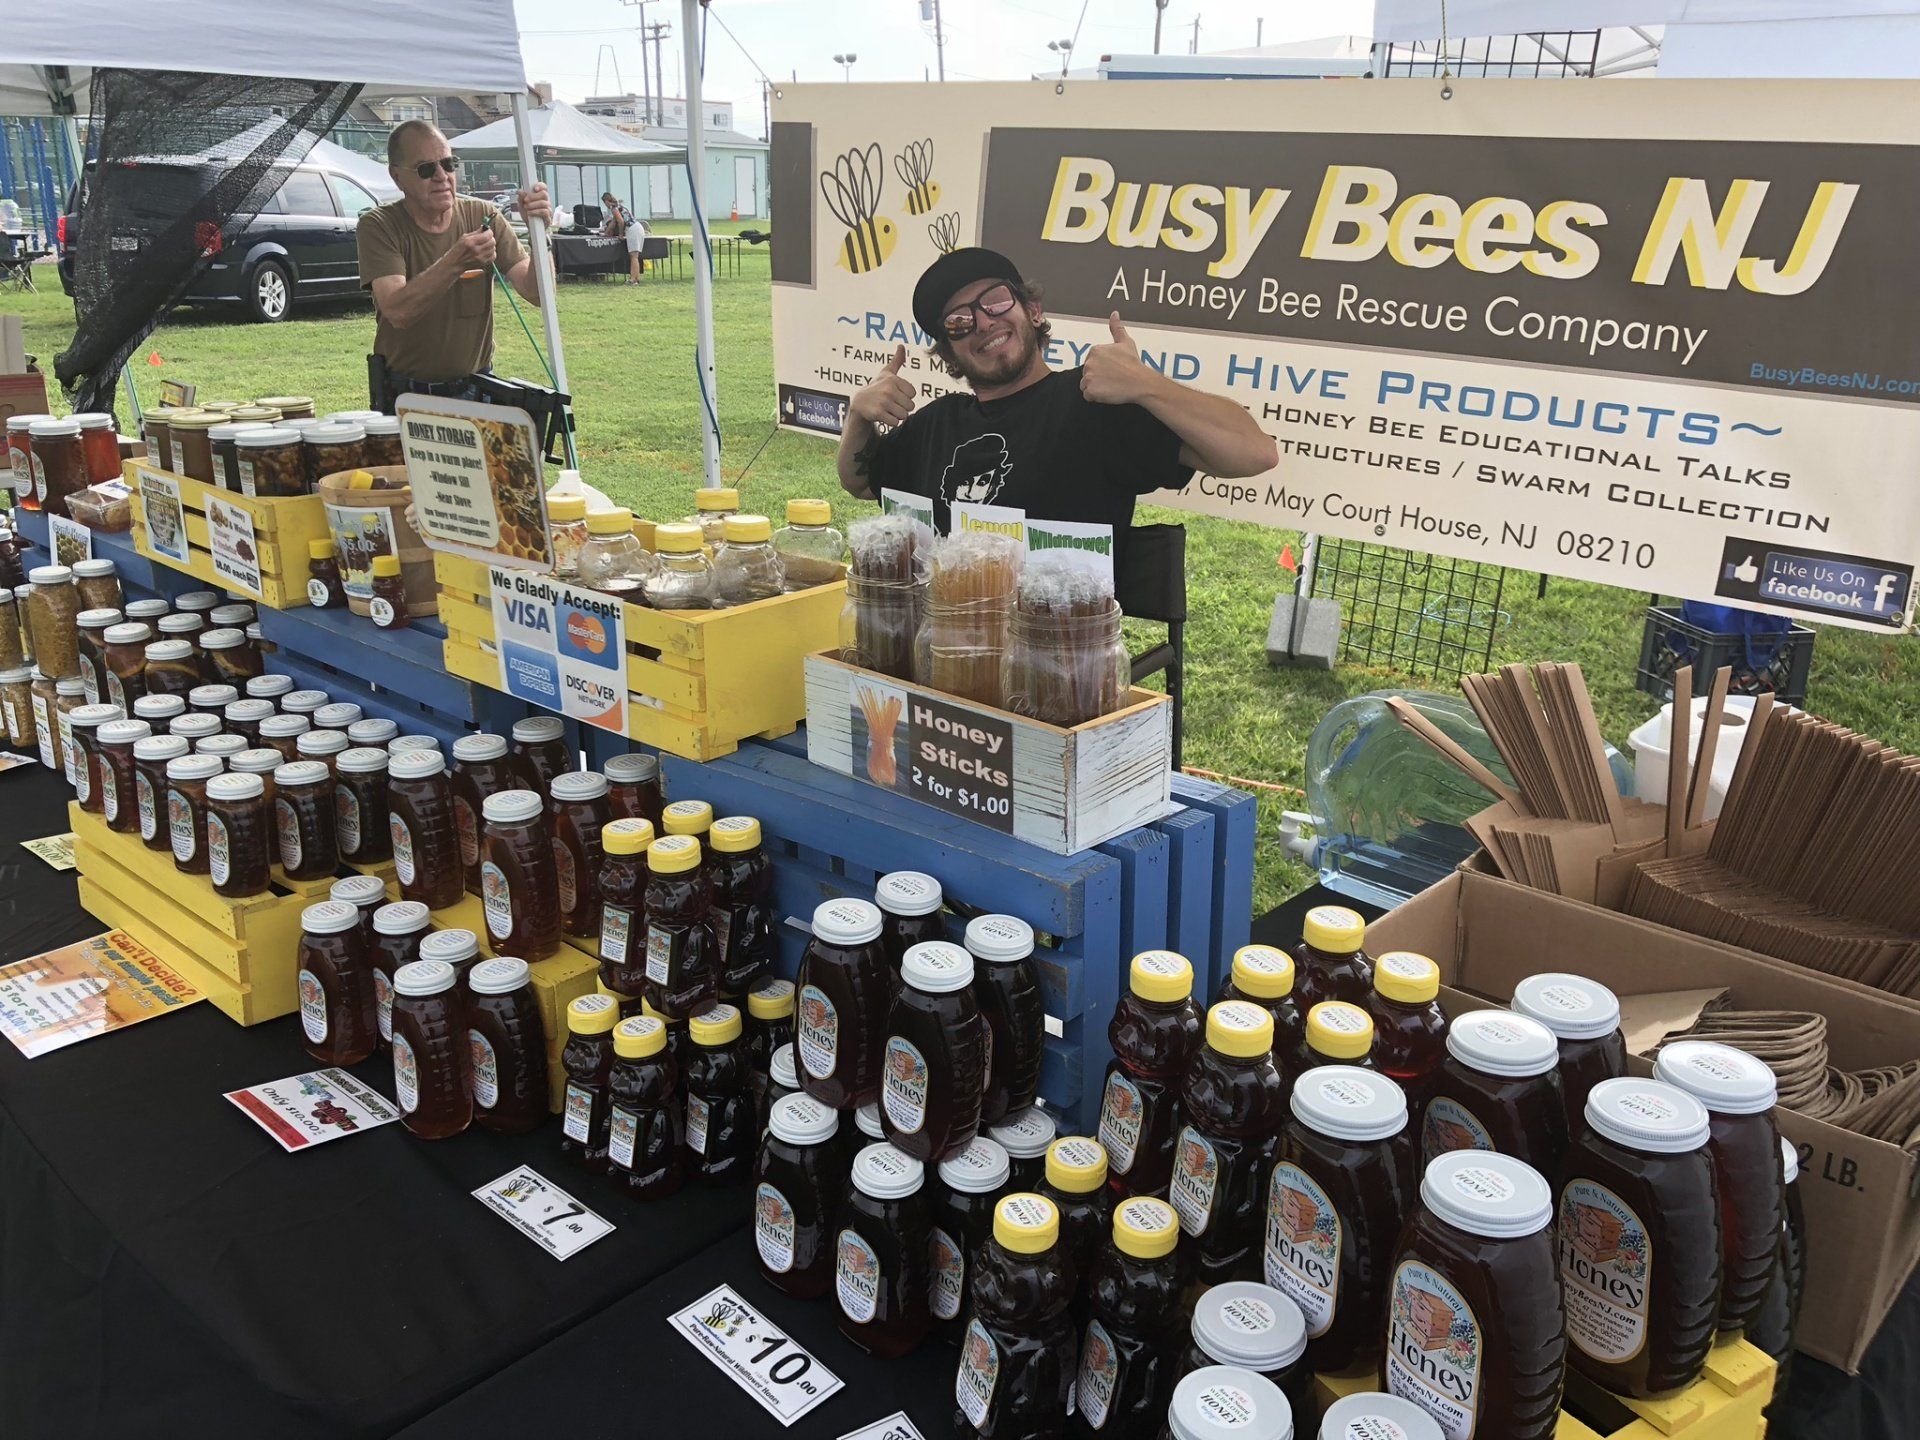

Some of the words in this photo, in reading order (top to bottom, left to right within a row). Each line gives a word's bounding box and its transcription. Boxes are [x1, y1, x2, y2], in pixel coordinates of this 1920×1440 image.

[1040, 156, 1292, 279] Busy
[1300, 164, 1608, 280] Bees
[1631, 176, 1861, 296] NJ
[1107, 266, 1130, 300] A
[1142, 273, 1246, 321] Honey
[1258, 278, 1321, 318] Bee
[1336, 284, 1468, 331] Rescue
[1485, 296, 1708, 365] Company
[844, 345, 920, 369] FARME'S
[1140, 350, 1200, 380] ND
[1227, 354, 1349, 400] HIVE
[798, 397, 813, 409] Like
[814, 401, 823, 411] Us
[824, 404, 834, 412] On
[798, 409, 836, 426] facebook
[436, 425, 477, 448] STORAGE
[1263, 402, 1356, 431] HONEY
[1369, 415, 1424, 442] BEE
[1440, 425, 1661, 473] EDUCATIONAL
[1677, 456, 1791, 489] TALKS
[1272, 436, 1441, 475] TRUCTURES
[1476, 464, 1591, 498] SWARM
[1607, 483, 1831, 533] COLLECTION
[960, 511, 1024, 542] Lemon
[1199, 475, 1257, 505] Cape
[1264, 484, 1315, 517] May
[1323, 493, 1392, 525] Court
[1399, 504, 1489, 546] House,
[1501, 520, 1539, 550] NJ
[1556, 528, 1656, 570] 08210
[1027, 526, 1112, 556] Wildflower
[1773, 560, 1808, 578] Like
[1813, 567, 1834, 582] Us
[1840, 571, 1866, 588] On
[491, 569, 511, 589] We
[515, 577, 559, 606] Gladly
[563, 590, 621, 619] Accept:
[1767, 577, 1863, 609] facebook
[501, 596, 551, 633] VISA
[567, 623, 605, 643] MasterCard
[510, 657, 551, 680] AMERICAN
[519, 673, 554, 696] EXPRESS
[913, 705, 1004, 754] Honey
[920, 741, 1010, 788] Sticks
[912, 765, 923, 786] 2
[928, 775, 953, 800] for
[957, 789, 1010, 816] $1.00
[982, 925, 1015, 940] HONEY
[110, 933, 146, 961] Can't
[139, 953, 198, 998] Decide?
[8, 992, 28, 1007] for
[1544, 990, 1581, 1010] HONEY
[800, 1018, 835, 1050] Honey
[1219, 1008, 1251, 1029] HONEY
[1477, 1025, 1513, 1043] HONEY
[1692, 1058, 1733, 1081] HONEY
[884, 1068, 924, 1105] Honey
[1322, 1083, 1358, 1106] HONEY
[262, 1087, 289, 1106] Only
[286, 1107, 320, 1132] $10.00
[786, 1105, 812, 1124] HONEY
[1102, 1103, 1138, 1146] Honey
[1454, 1109, 1482, 1136] Natural
[1619, 1098, 1666, 1121] HONEY
[1011, 1122, 1038, 1137] ONEY
[869, 1156, 898, 1176] HONEY
[960, 1154, 985, 1169] ONEY
[1059, 1145, 1086, 1166] HONEY
[1798, 1143, 1815, 1173] 2
[1822, 1152, 1865, 1193] LB.
[1174, 1166, 1210, 1206] Honey
[1300, 1180, 1325, 1207] Natural
[1455, 1173, 1497, 1200] HONEY
[1008, 1201, 1033, 1226] HONEY
[1126, 1207, 1156, 1231] HONEY
[1575, 1184, 1589, 1198] Pure
[1600, 1194, 1633, 1224] Natural
[520, 1218, 543, 1240] Wildflower
[757, 1213, 791, 1247] Honey
[1268, 1219, 1333, 1288] Honey
[838, 1259, 875, 1297] Honey
[1267, 1252, 1326, 1304] BusyBeesNJ.com
[1407, 1267, 1423, 1282] Pure
[1432, 1278, 1464, 1312] Natural
[1560, 1240, 1644, 1308] Honey
[1564, 1277, 1637, 1326] usyBeesNJ.com
[1223, 1305, 1261, 1330] HONEY
[690, 1323, 735, 1365] Pure-Raw-Natural
[734, 1362, 763, 1389] Wildflower
[761, 1387, 780, 1405] Honey
[1390, 1322, 1472, 1402] Honey
[1210, 1387, 1249, 1421] WILDFLOWER
[1391, 1358, 1464, 1419] BusyBeesNJ.com
[1200, 1394, 1240, 1424] HONEY
